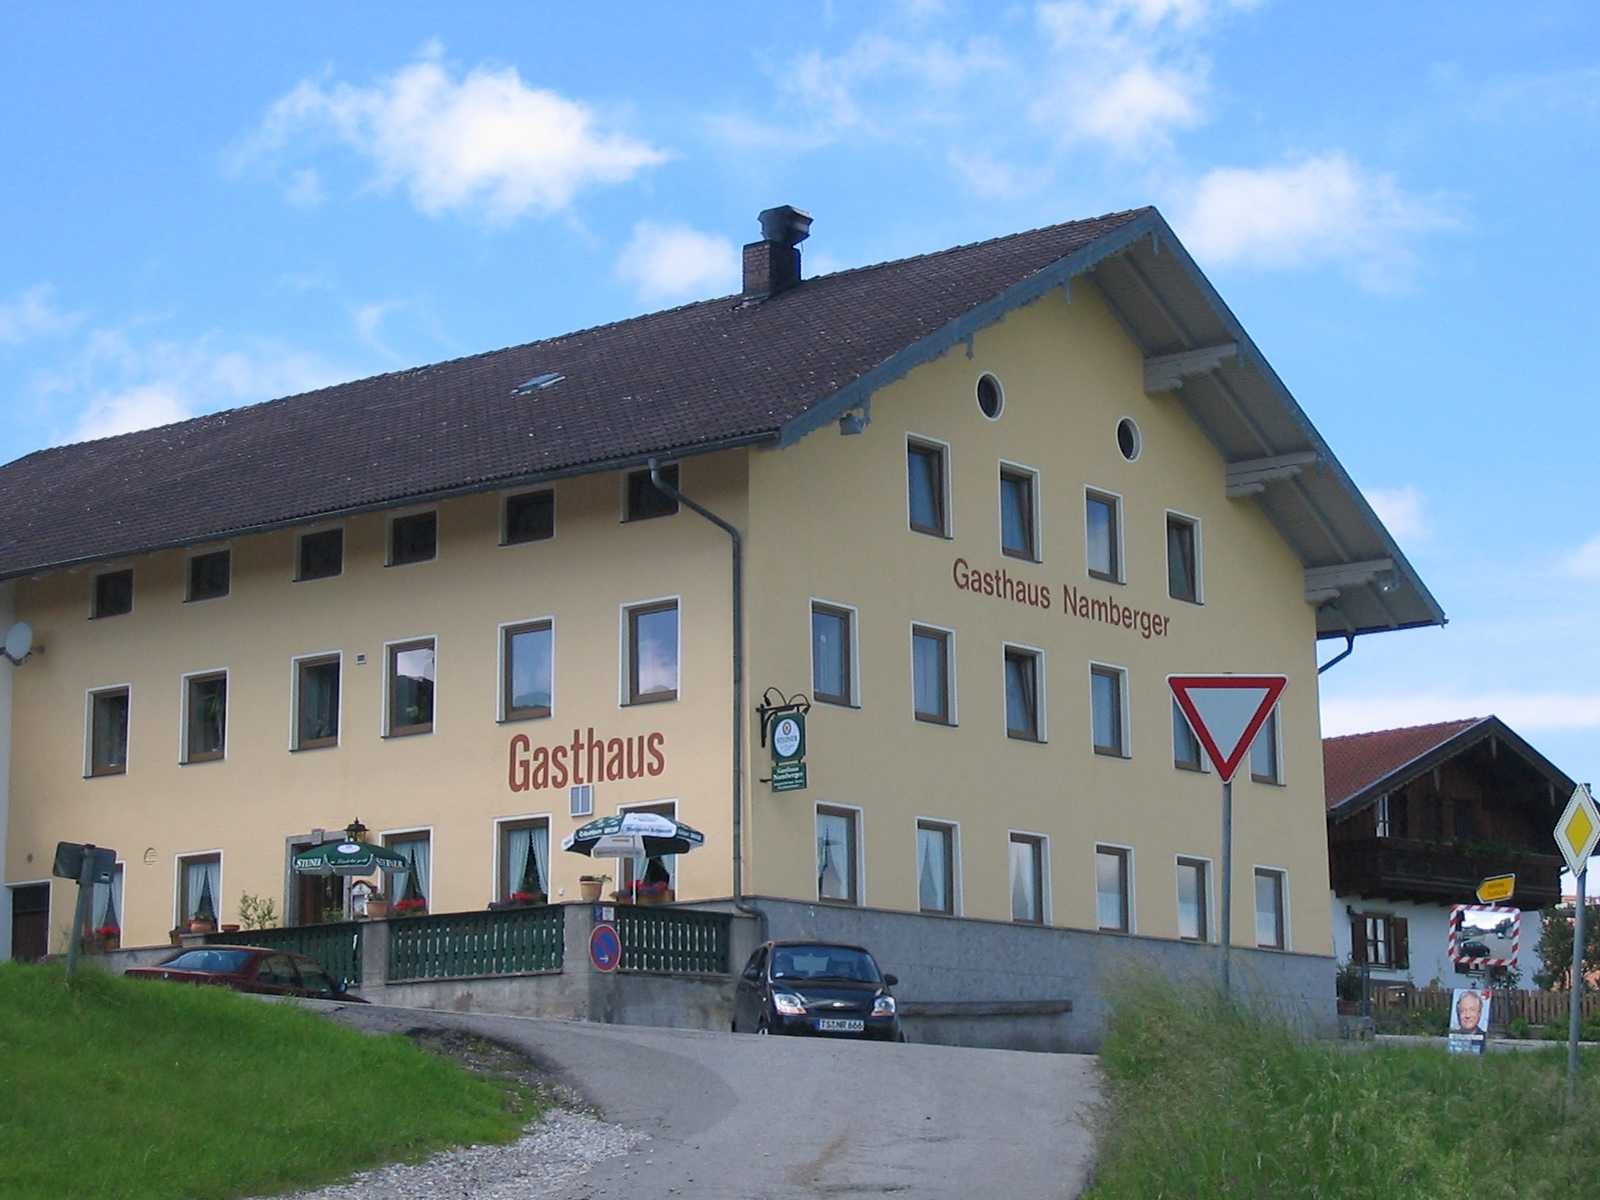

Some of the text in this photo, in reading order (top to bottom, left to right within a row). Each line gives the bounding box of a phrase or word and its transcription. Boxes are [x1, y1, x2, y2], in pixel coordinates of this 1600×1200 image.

[953, 558, 1170, 639] Gasthaus Namberger
[508, 727, 665, 793] Gasthaus
